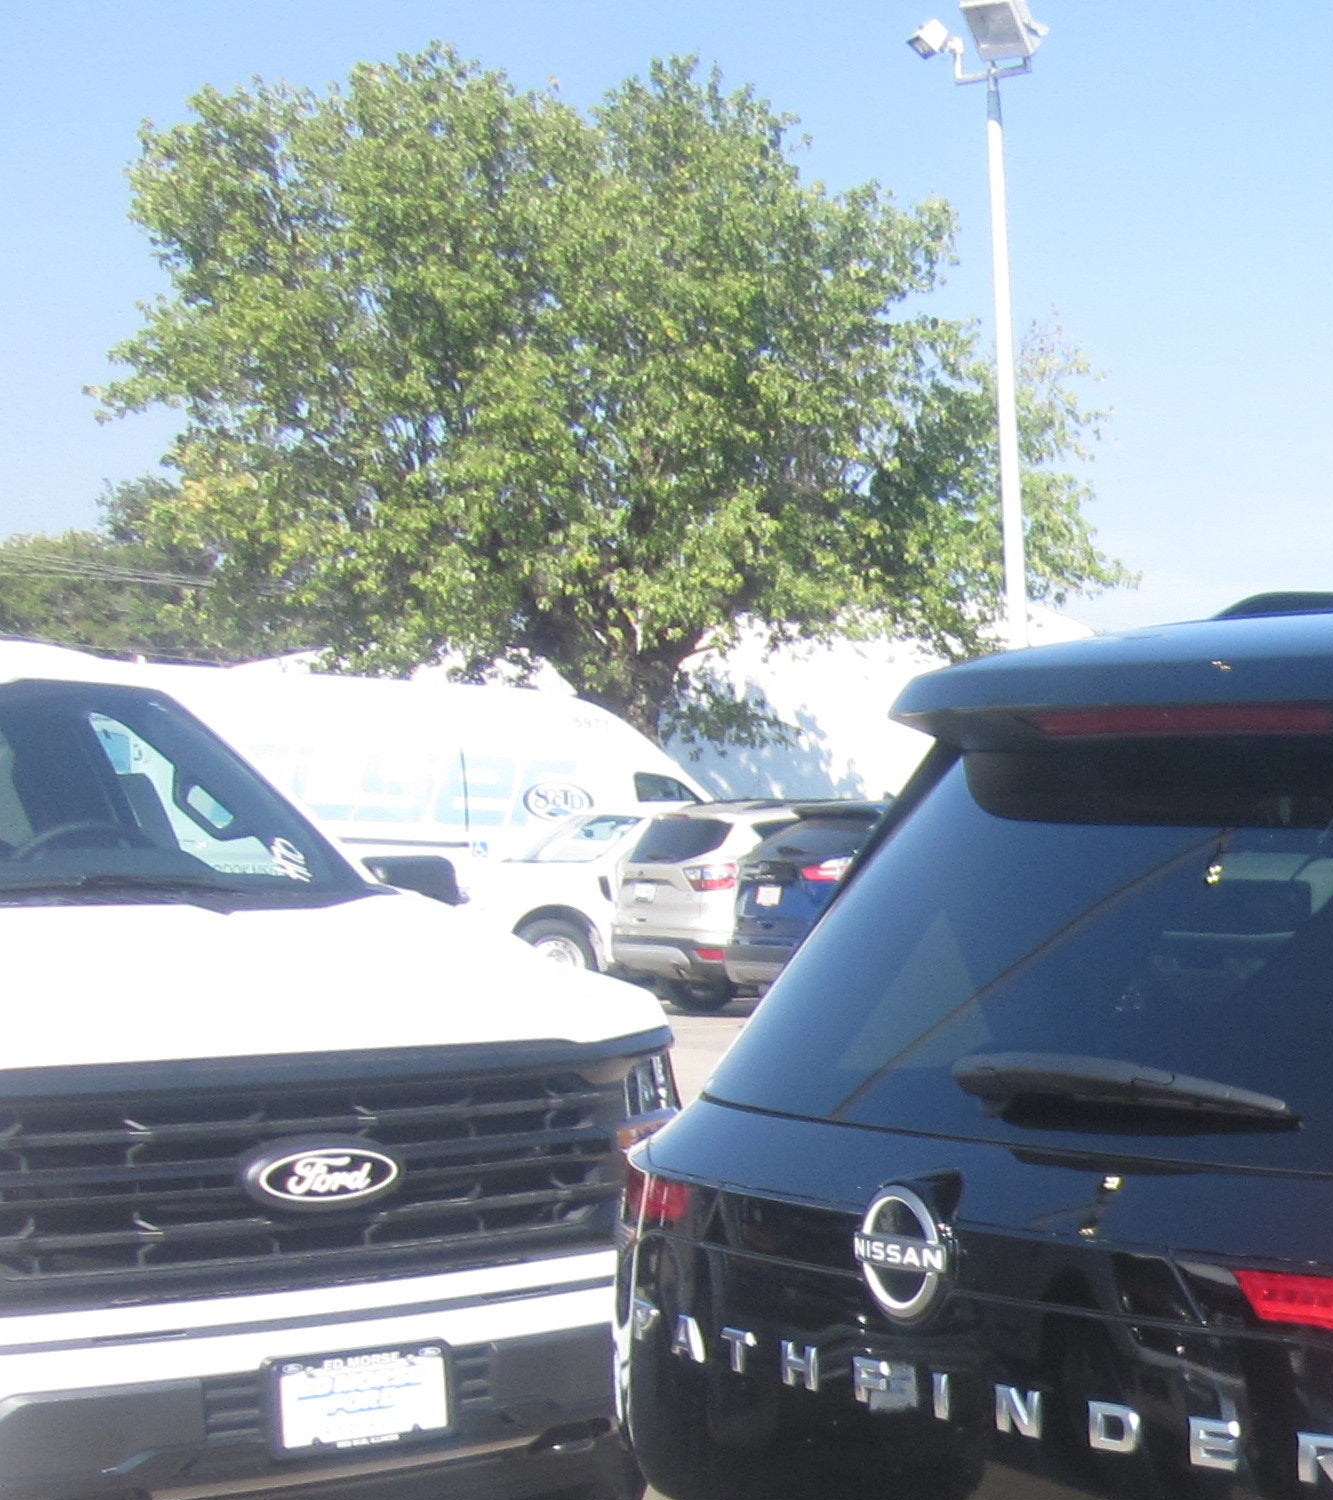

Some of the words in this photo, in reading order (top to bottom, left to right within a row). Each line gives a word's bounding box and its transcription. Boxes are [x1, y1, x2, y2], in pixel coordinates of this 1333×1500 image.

[286, 1155, 373, 1195] Ford
[854, 1236, 944, 1271] NISSAN
[323, 1358, 344, 1371] ED
[347, 1351, 401, 1369] MORSE
